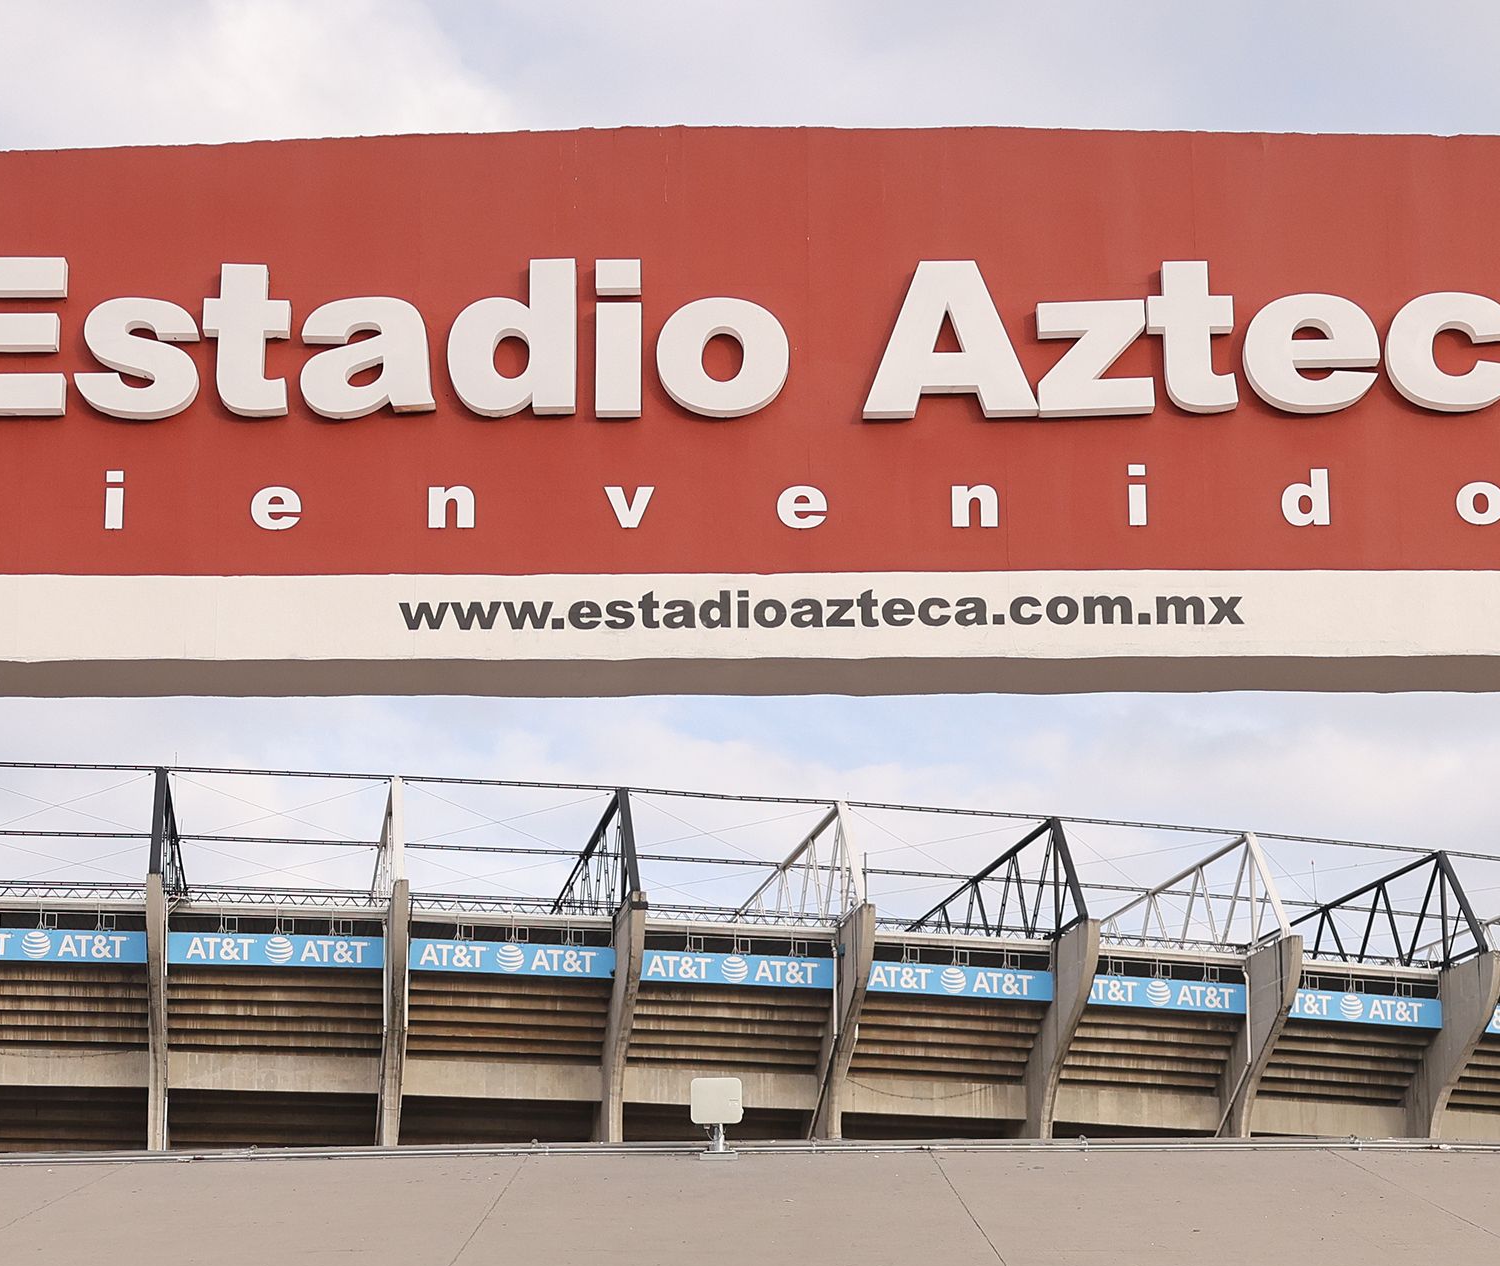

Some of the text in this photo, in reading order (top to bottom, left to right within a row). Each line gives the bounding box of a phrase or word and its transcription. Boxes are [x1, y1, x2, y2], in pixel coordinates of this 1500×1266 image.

[398, 590, 1245, 630] www.estadioazteca.com.mx
[58, 935, 126, 958] AT&T
[186, 937, 367, 963] AT&T AT&T
[419, 943, 597, 973] AT&T AT&T
[647, 954, 817, 985] AT&T AT&T
[870, 966, 1033, 996] AT&T AT&T
[1176, 984, 1235, 1009] AT&T
[1292, 992, 1422, 1023] T&T AT&T
